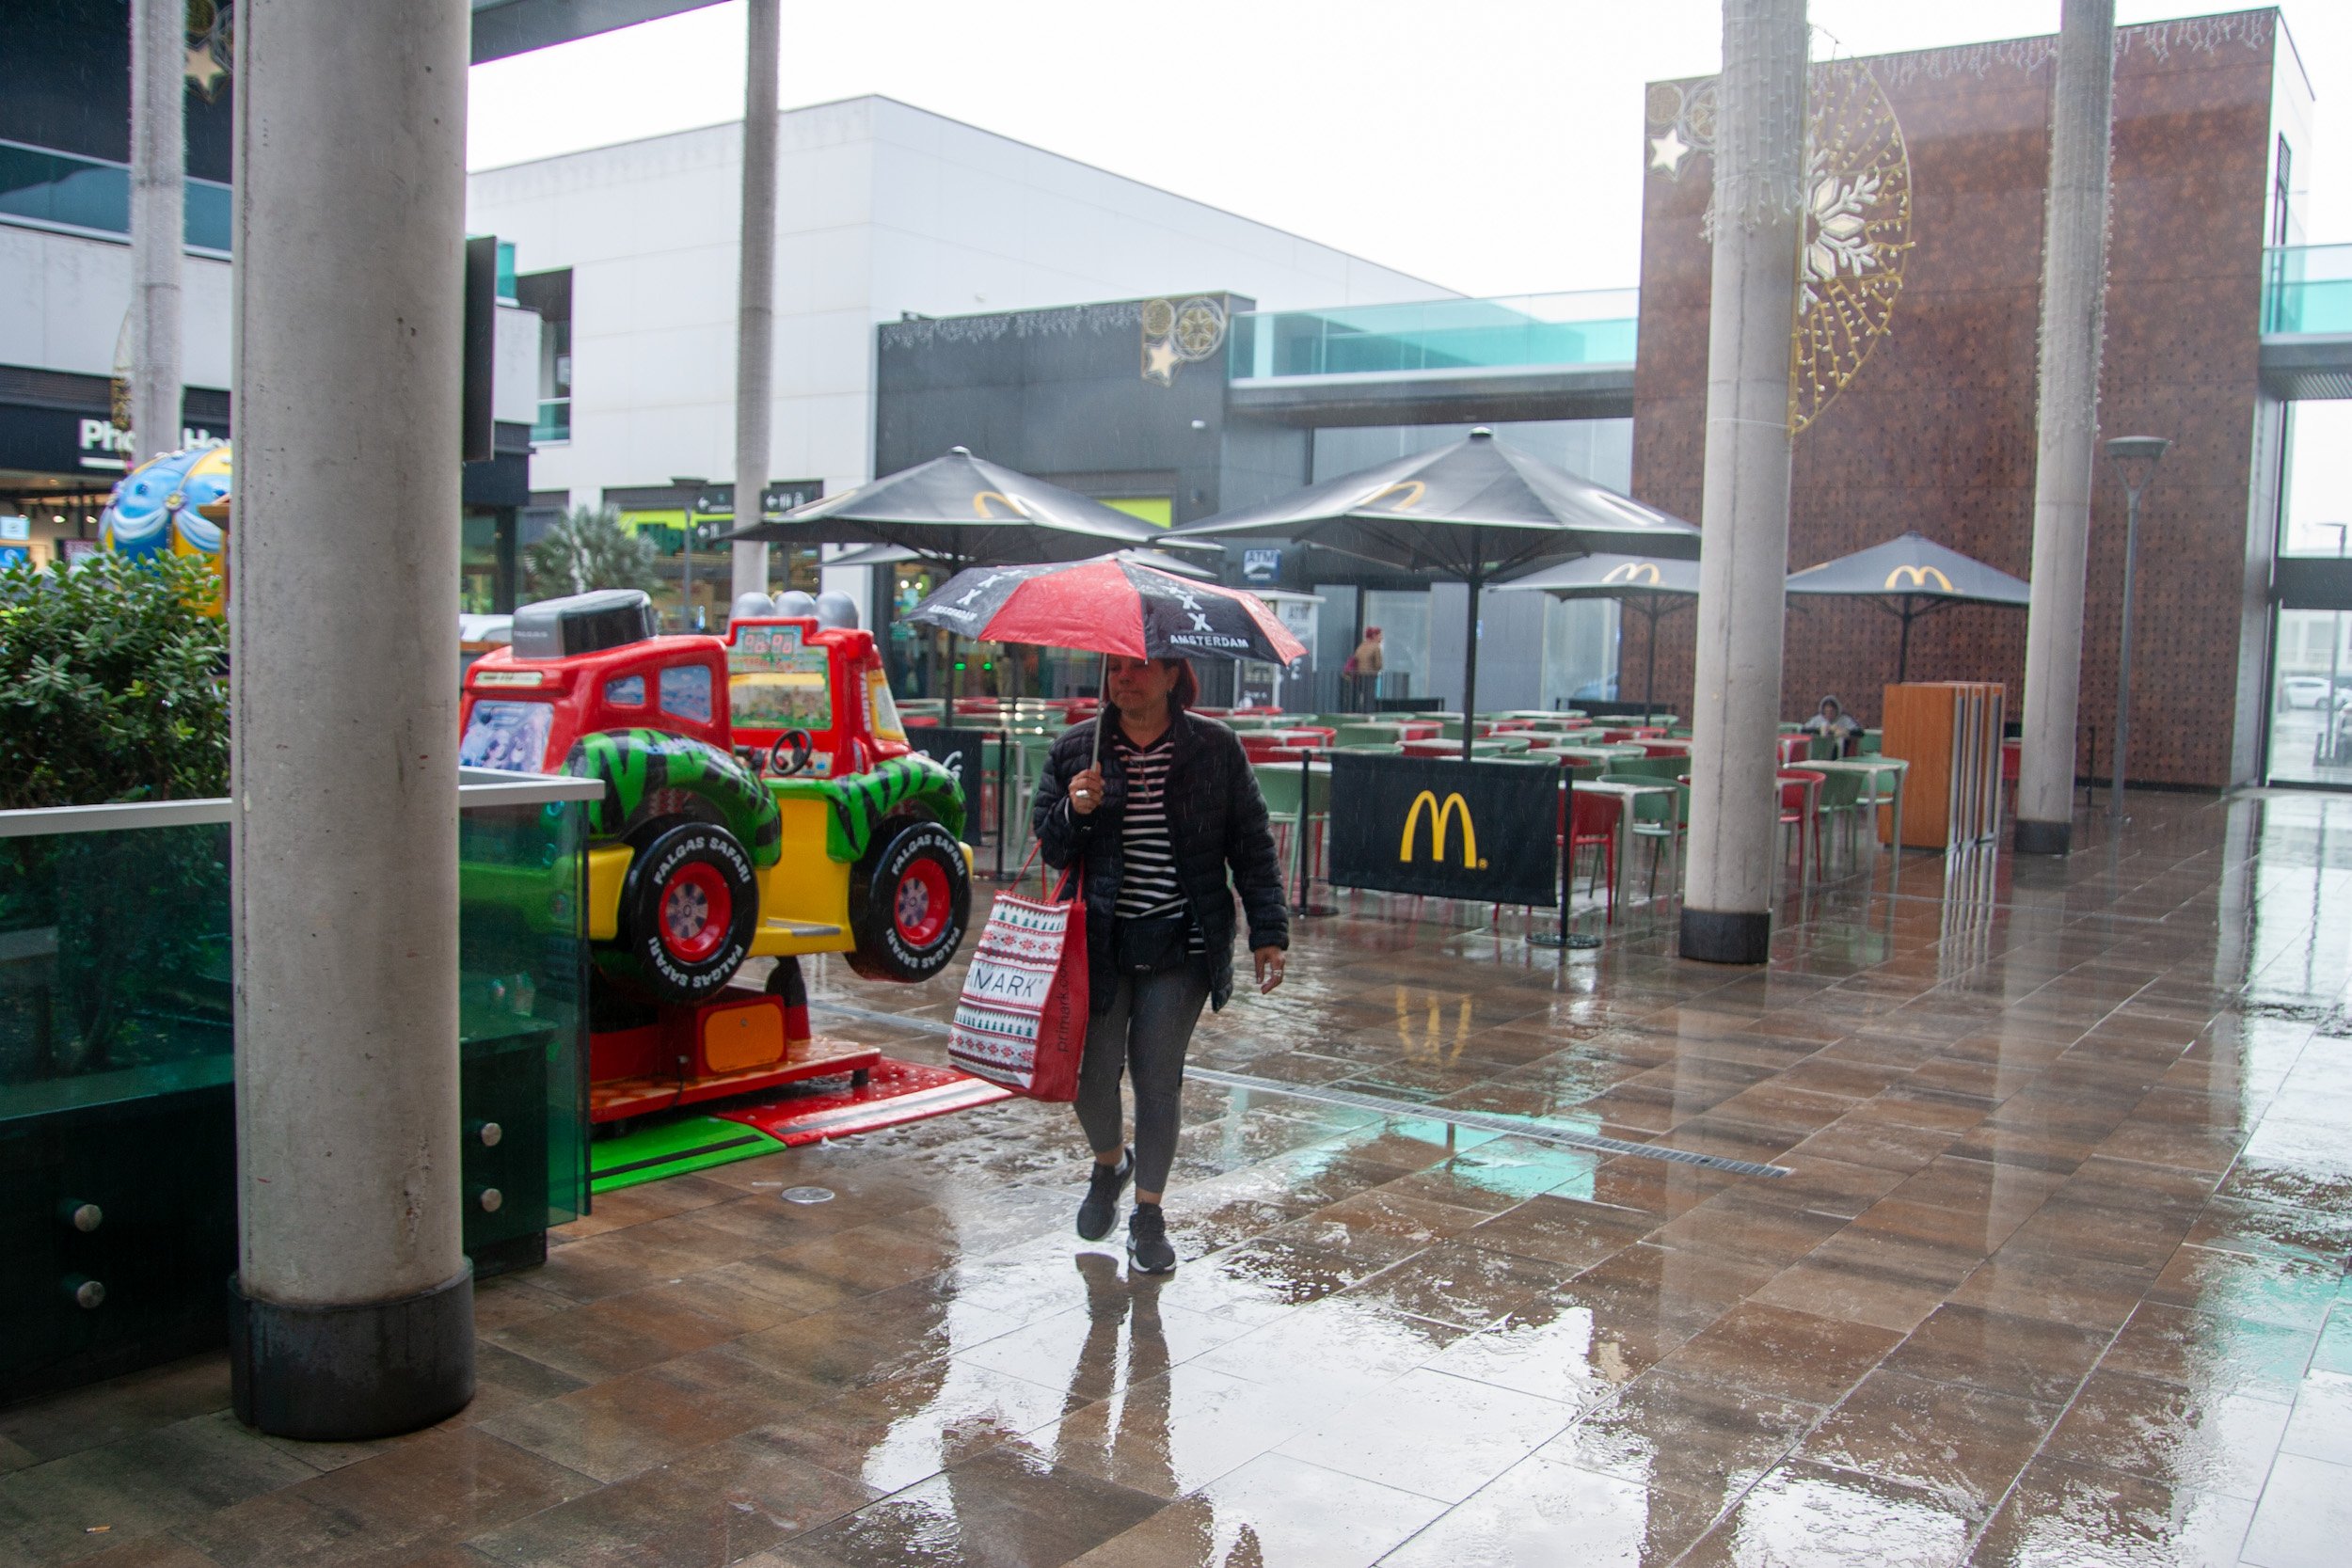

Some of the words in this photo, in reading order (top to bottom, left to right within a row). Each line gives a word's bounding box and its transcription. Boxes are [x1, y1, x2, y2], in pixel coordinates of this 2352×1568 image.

[80, 419, 135, 452] Pho
[1248, 551, 1275, 563] ATM
[928, 604, 978, 622] AMSTERDAM
[1169, 634, 1249, 648] AMSTERDAM
[1400, 790, 1477, 869] M
[654, 836, 705, 885] FALGAS
[708, 836, 751, 883] SAFARI
[892, 833, 932, 876] FALGAS
[933, 834, 966, 877] SAFARI
[648, 936, 689, 987] SAFARI
[692, 944, 744, 988] FALGAS
[885, 927, 919, 969] SAFARI
[922, 927, 961, 969] FALGAS
[973, 968, 1038, 998] MARK
